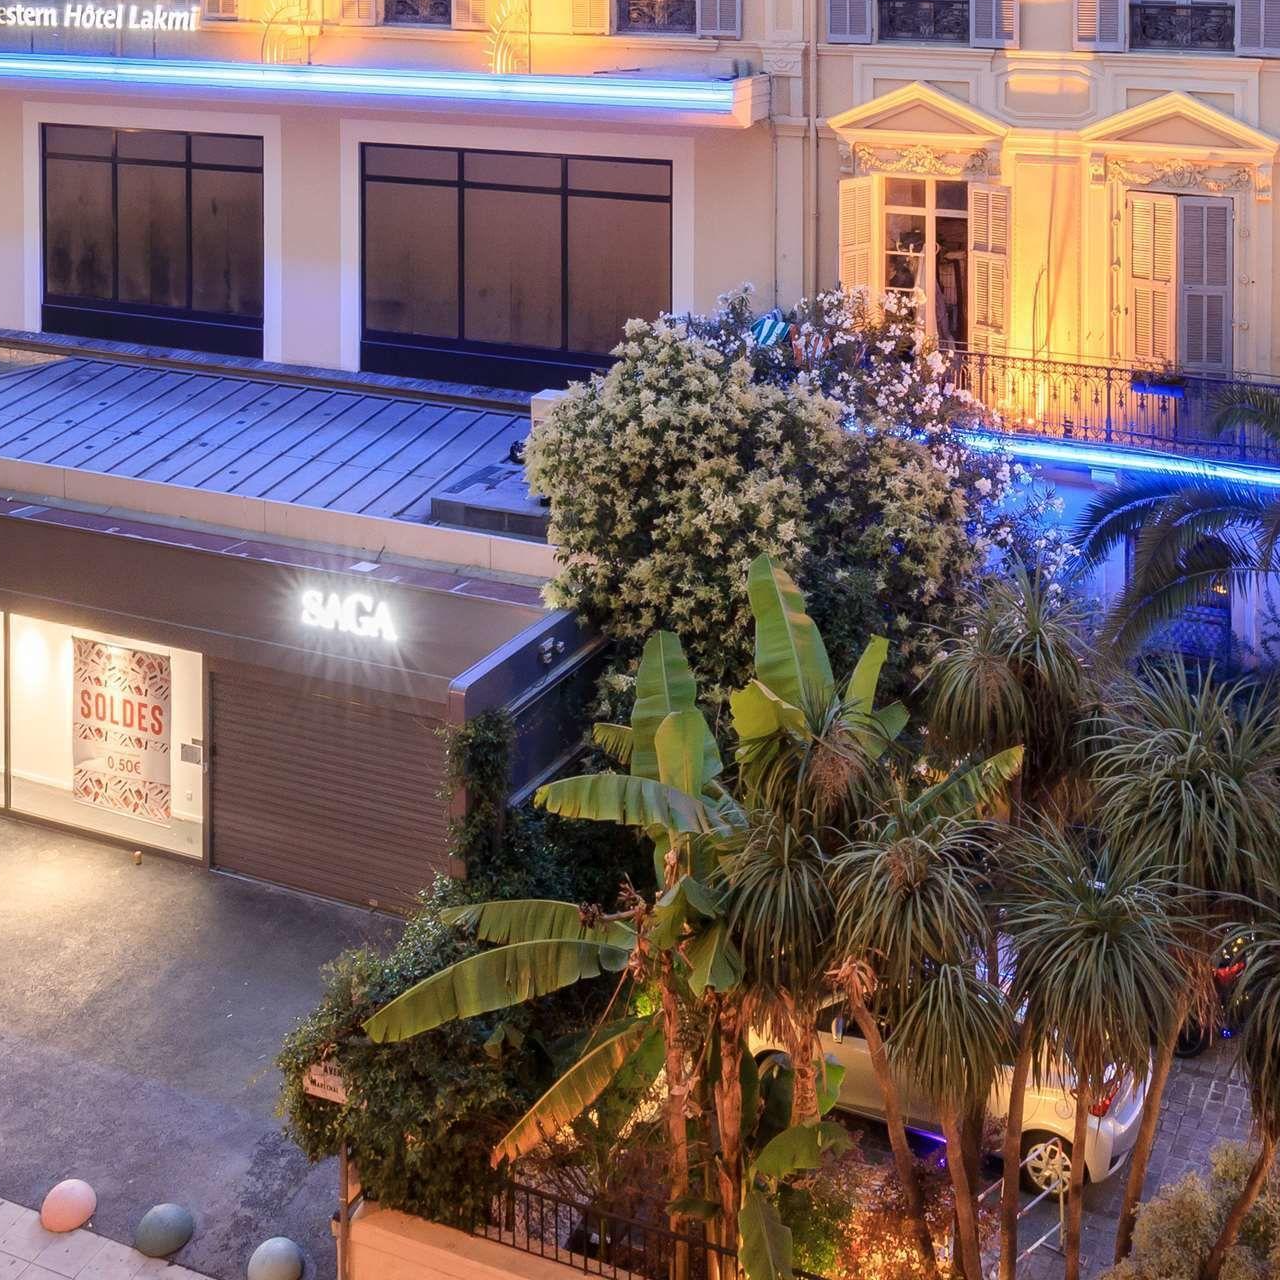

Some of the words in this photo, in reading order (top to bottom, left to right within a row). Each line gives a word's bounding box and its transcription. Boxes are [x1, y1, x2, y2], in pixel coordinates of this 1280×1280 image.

[64, 4, 123, 29] Hôtel
[129, 5, 200, 32] Lakmi
[301, 589, 399, 642] SAGA
[80, 689, 164, 736] SOLDES
